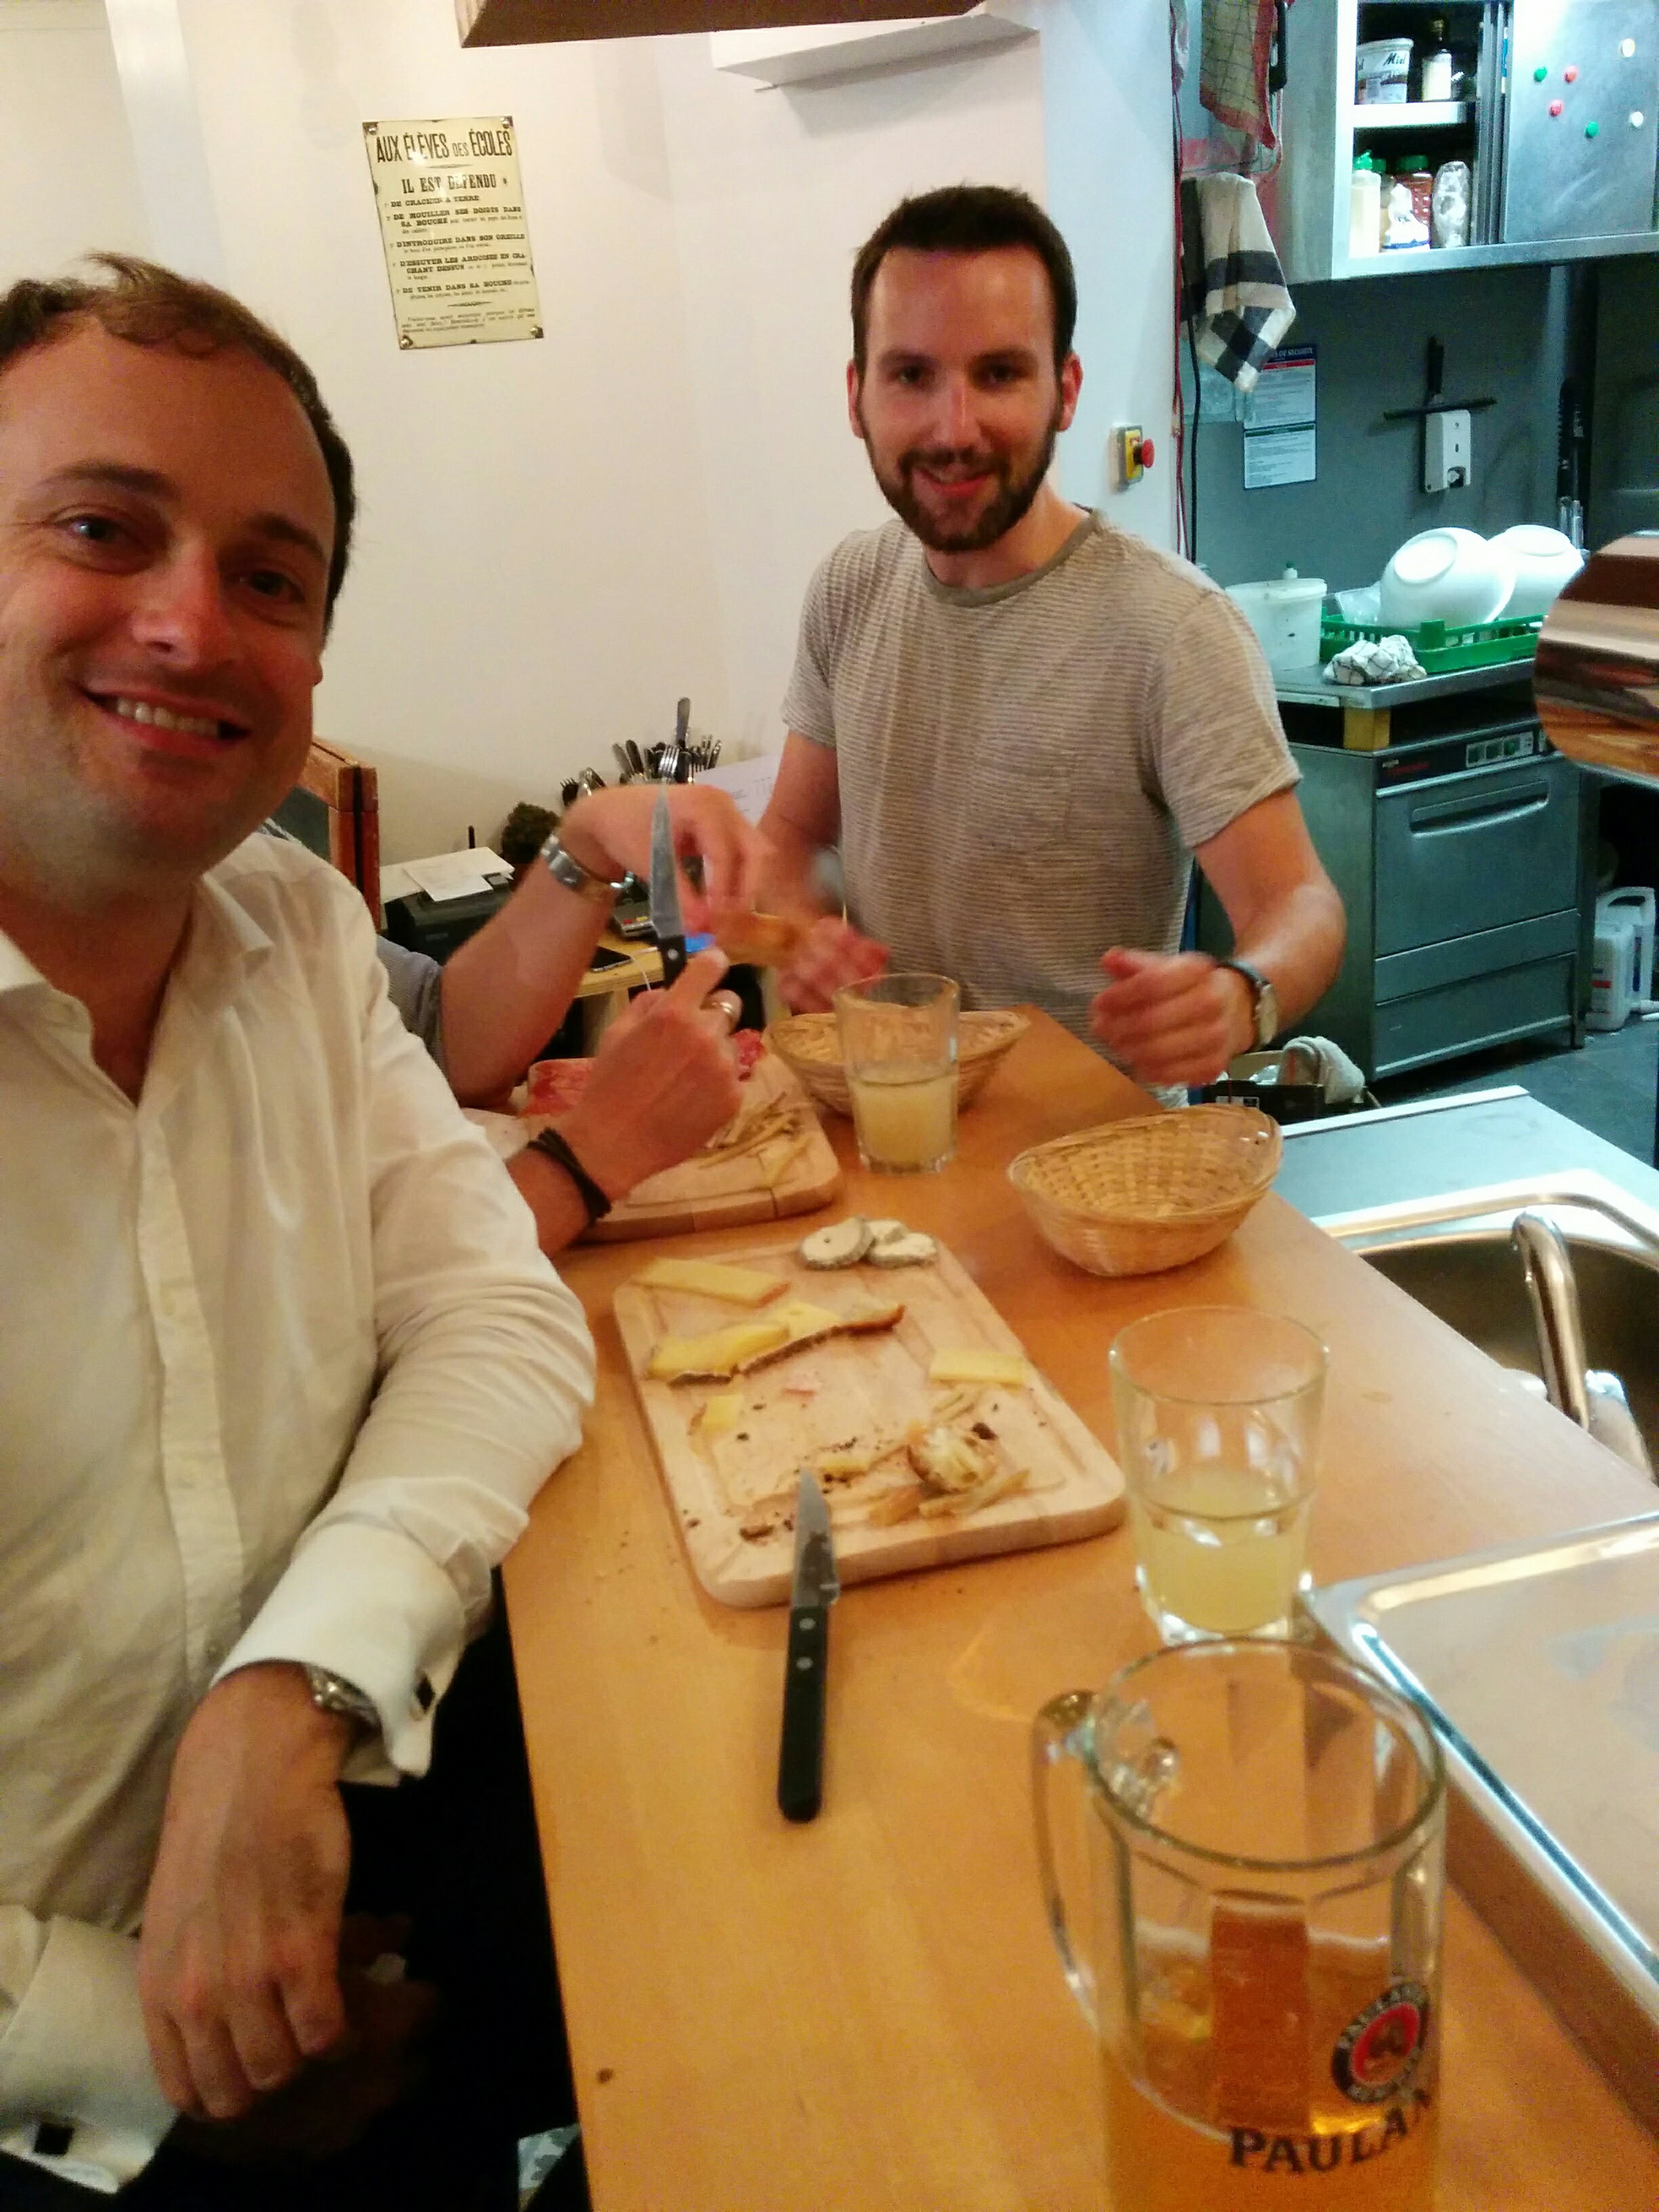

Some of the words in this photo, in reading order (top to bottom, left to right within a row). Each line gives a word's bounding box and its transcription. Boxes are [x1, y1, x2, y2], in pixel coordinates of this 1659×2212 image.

[1383, 52, 1406, 66] Miel
[376, 136, 403, 163] AUX
[452, 142, 469, 157] DES
[469, 128, 513, 157] ÉCOLES
[401, 178, 415, 194] IL
[419, 176, 441, 192] EST
[405, 197, 443, 206] CRACHER
[409, 209, 450, 219] MOUILLER
[415, 218, 448, 226] BOUCHE
[483, 279, 512, 287] BOUCHE
